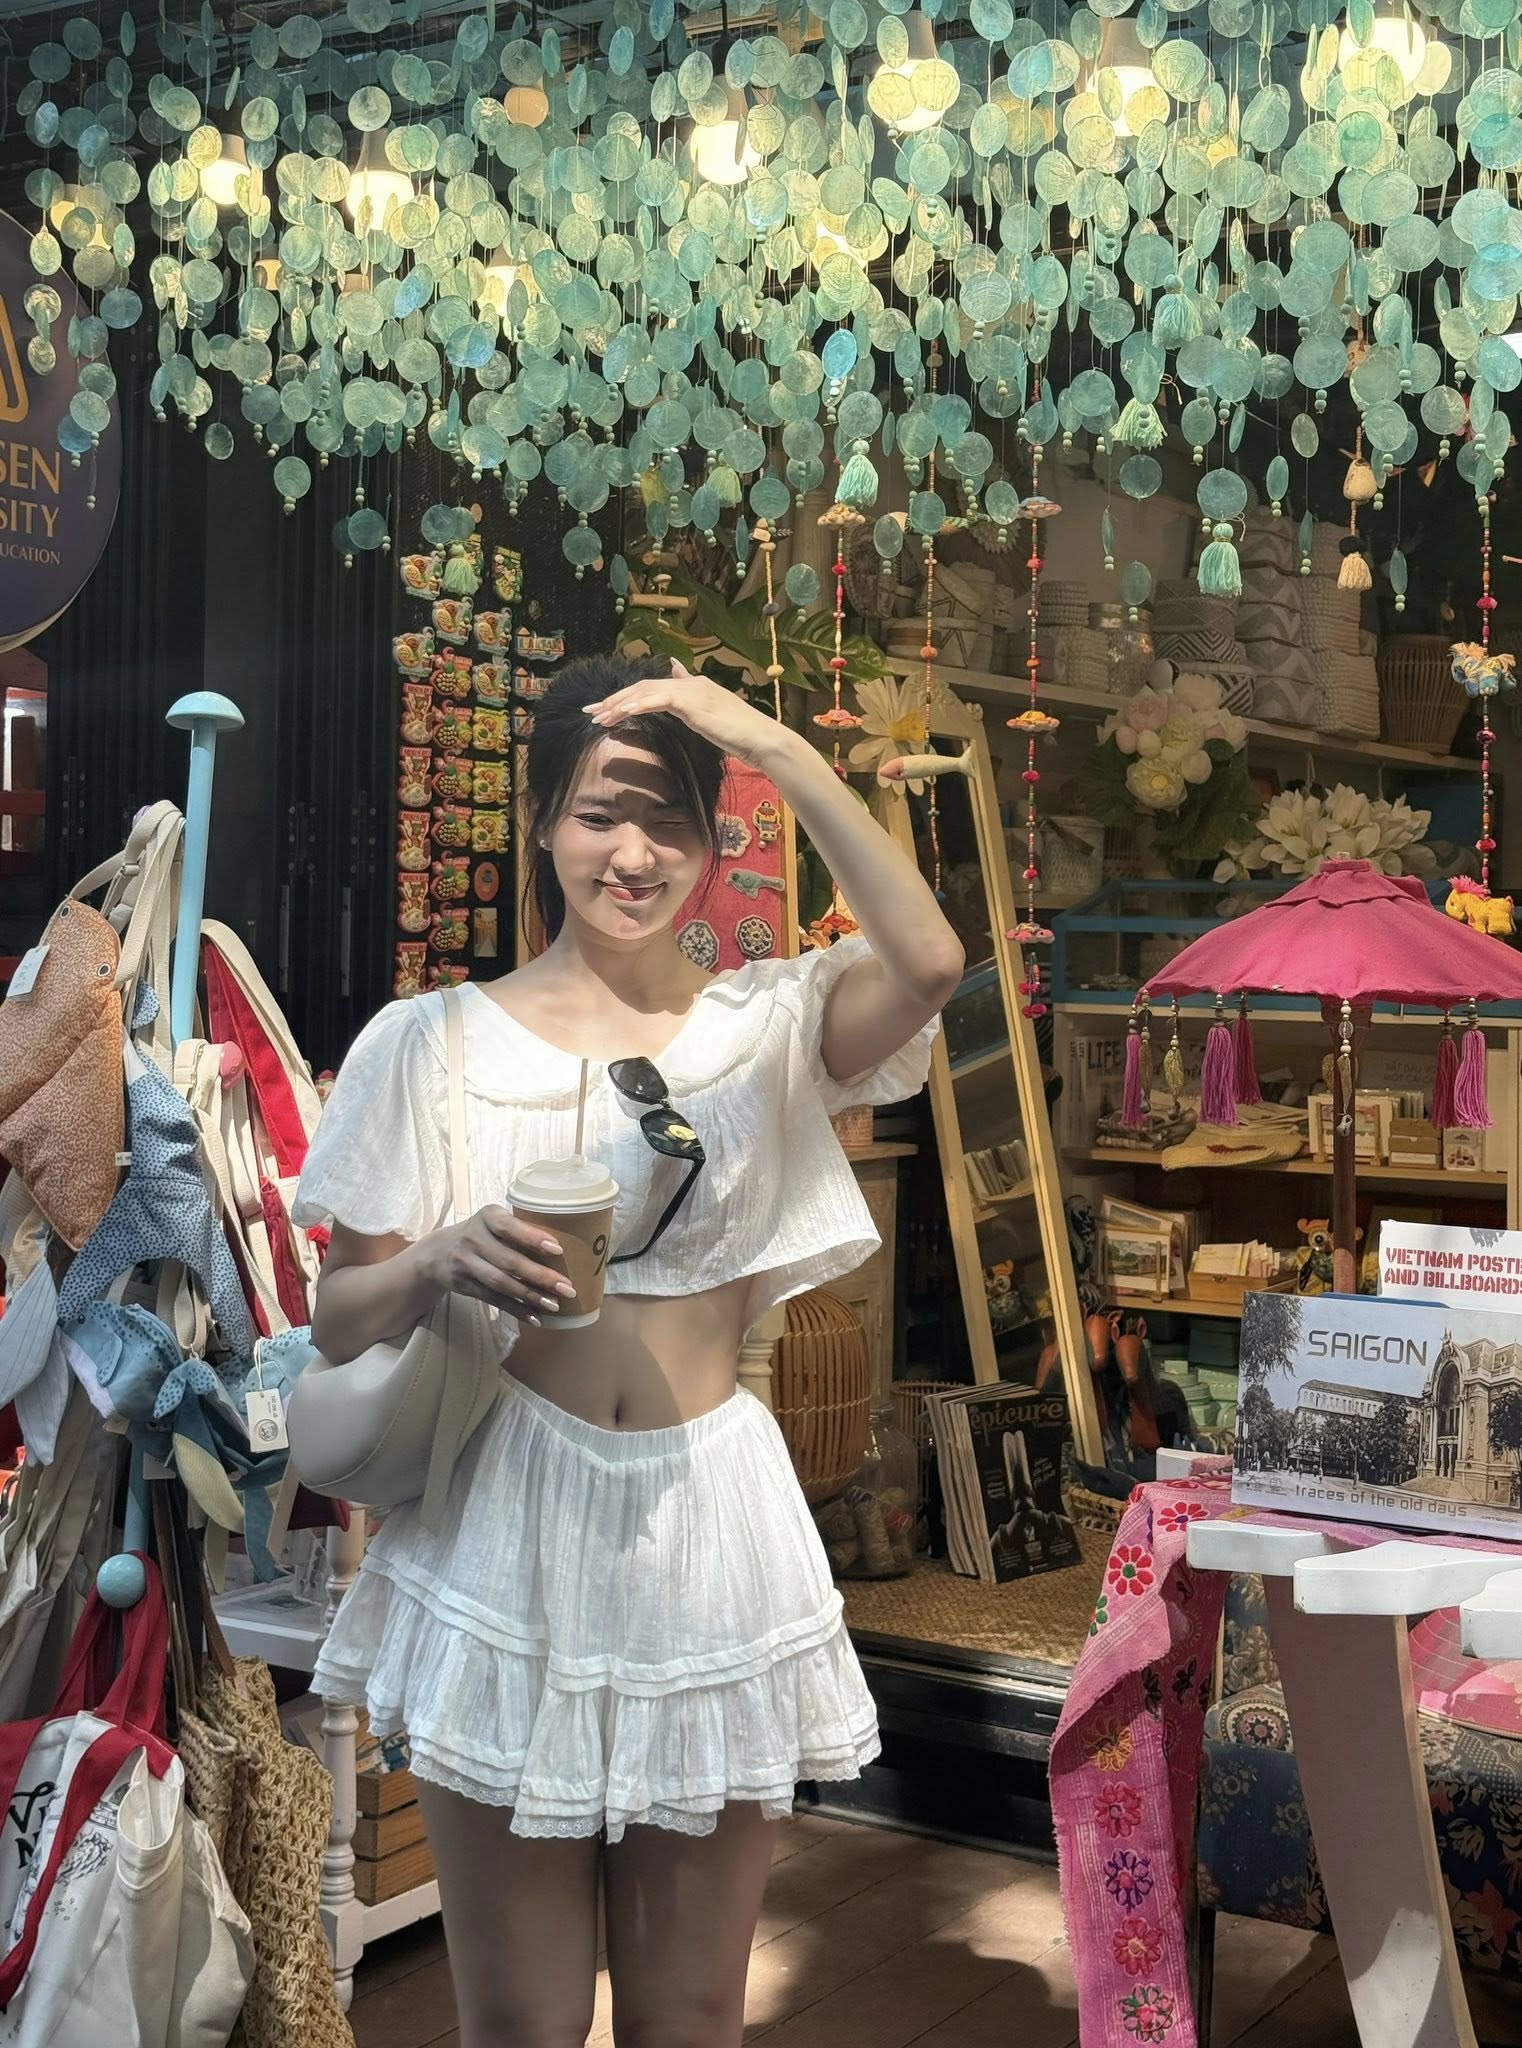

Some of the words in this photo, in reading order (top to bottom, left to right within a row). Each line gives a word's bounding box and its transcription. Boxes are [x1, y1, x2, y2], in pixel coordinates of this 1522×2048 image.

[0, 543, 60, 565] UCATION
[1385, 1247, 1464, 1270] VIETNAM
[1384, 1267, 1419, 1287] AND
[1423, 1270, 1522, 1295] BILLBOARD
[1306, 1329, 1428, 1367] SAIGON
[1296, 1483, 1344, 1501] traces
[1351, 1490, 1365, 1504] of
[1371, 1493, 1395, 1508] the
[1400, 1498, 1423, 1511] old
[1428, 1500, 1467, 1518] days
